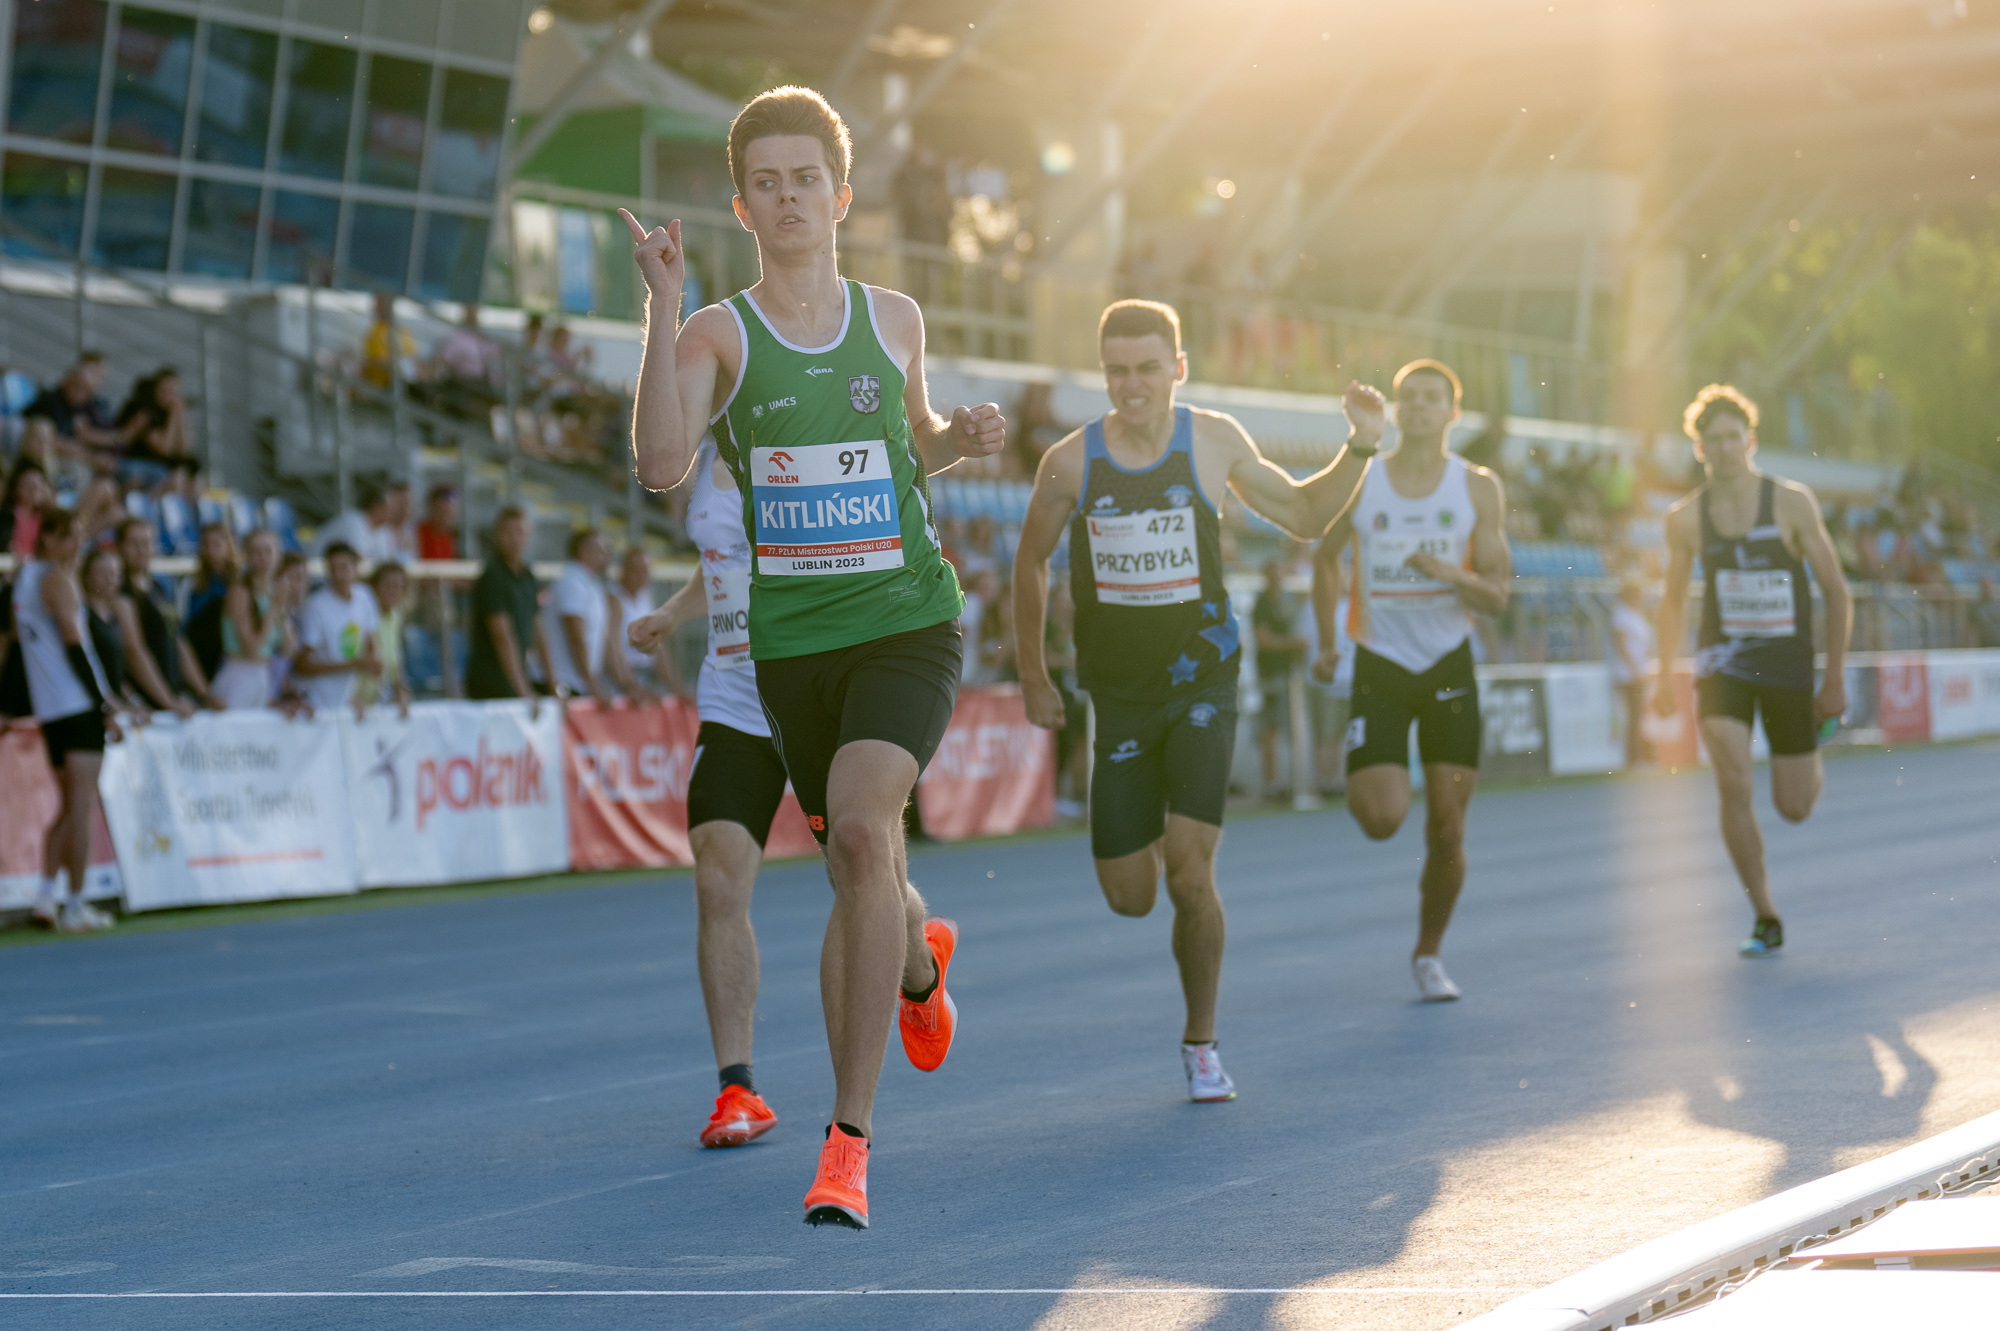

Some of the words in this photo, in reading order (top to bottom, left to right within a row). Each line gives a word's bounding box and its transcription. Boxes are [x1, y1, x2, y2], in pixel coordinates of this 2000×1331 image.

[768, 396, 797, 411] UMCS
[838, 449, 869, 476] 97
[767, 475, 799, 484] ORLEN
[760, 492, 891, 529] KITLIŃSKI
[1147, 514, 1184, 534] 472
[767, 547, 778, 555] 77.
[778, 547, 796, 556] PZLA
[797, 546, 848, 556] Mistrzostwa
[850, 543, 875, 552] Polski
[875, 541, 892, 550] U20
[792, 560, 832, 570] LUBLIN
[835, 557, 865, 568] 2023
[1096, 547, 1195, 573] PRZYBYŁA
